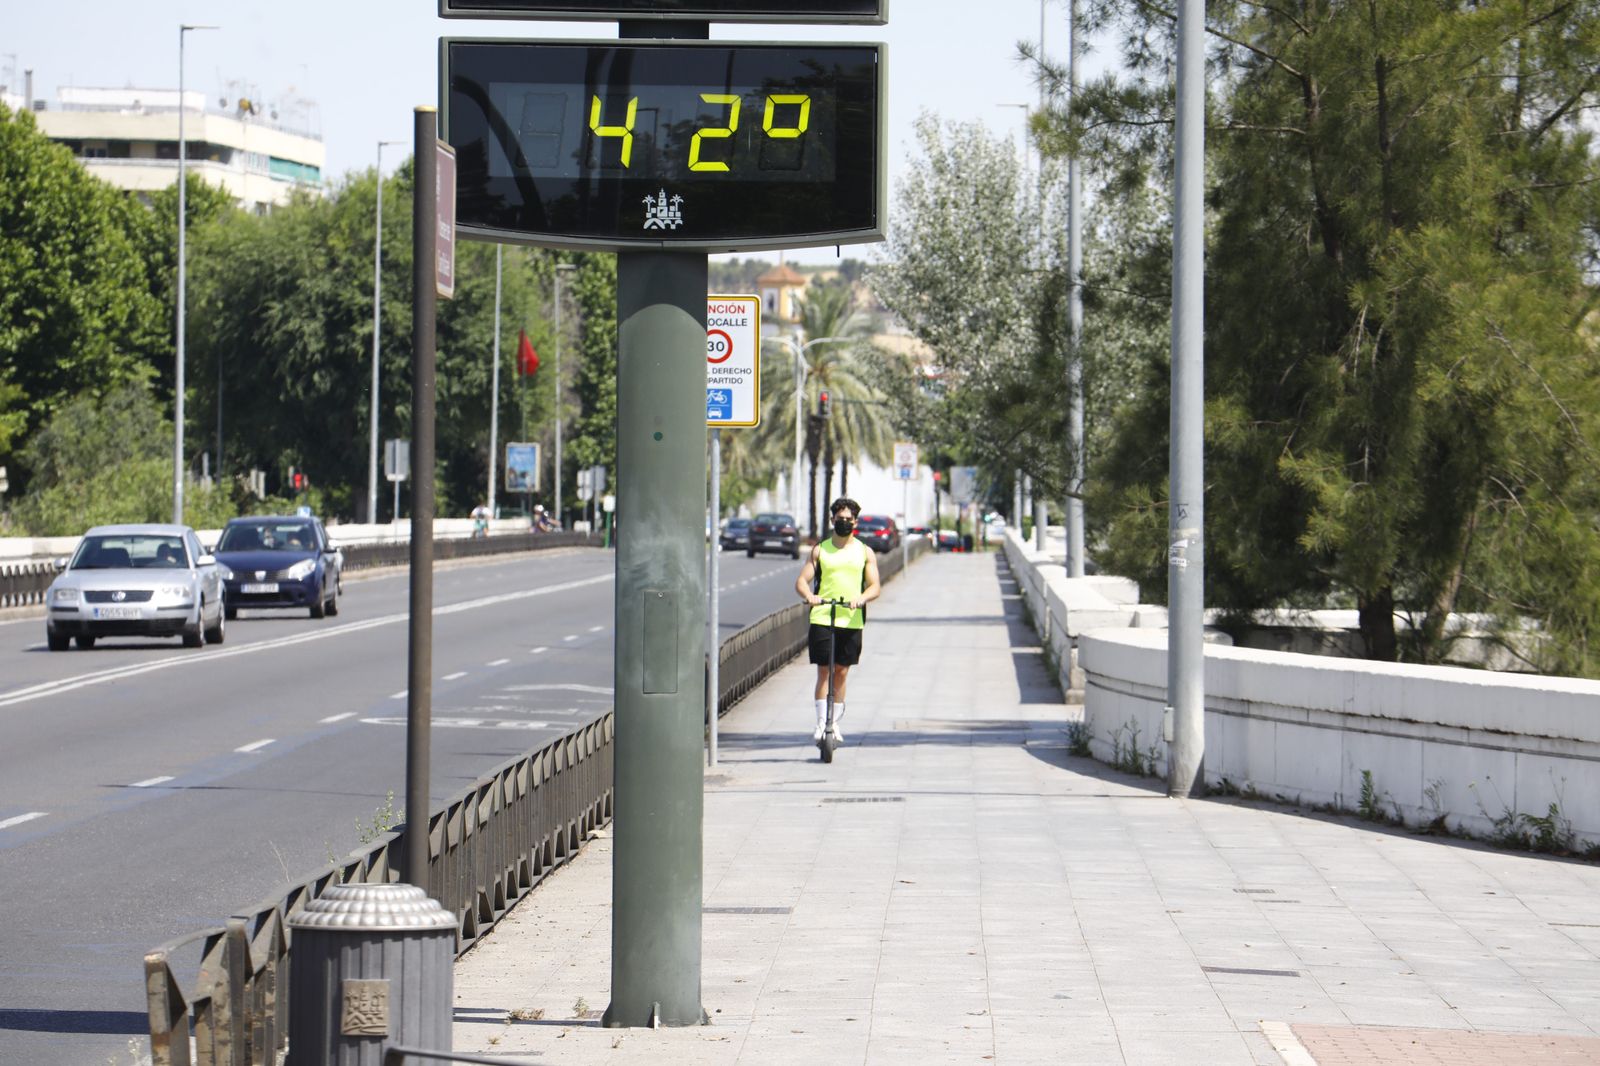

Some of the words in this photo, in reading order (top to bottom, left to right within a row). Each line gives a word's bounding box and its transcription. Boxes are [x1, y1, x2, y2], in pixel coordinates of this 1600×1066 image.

[708, 303, 746, 314] NCIÓN
[707, 318, 748, 327] OCALLE
[707, 341, 725, 352] 30
